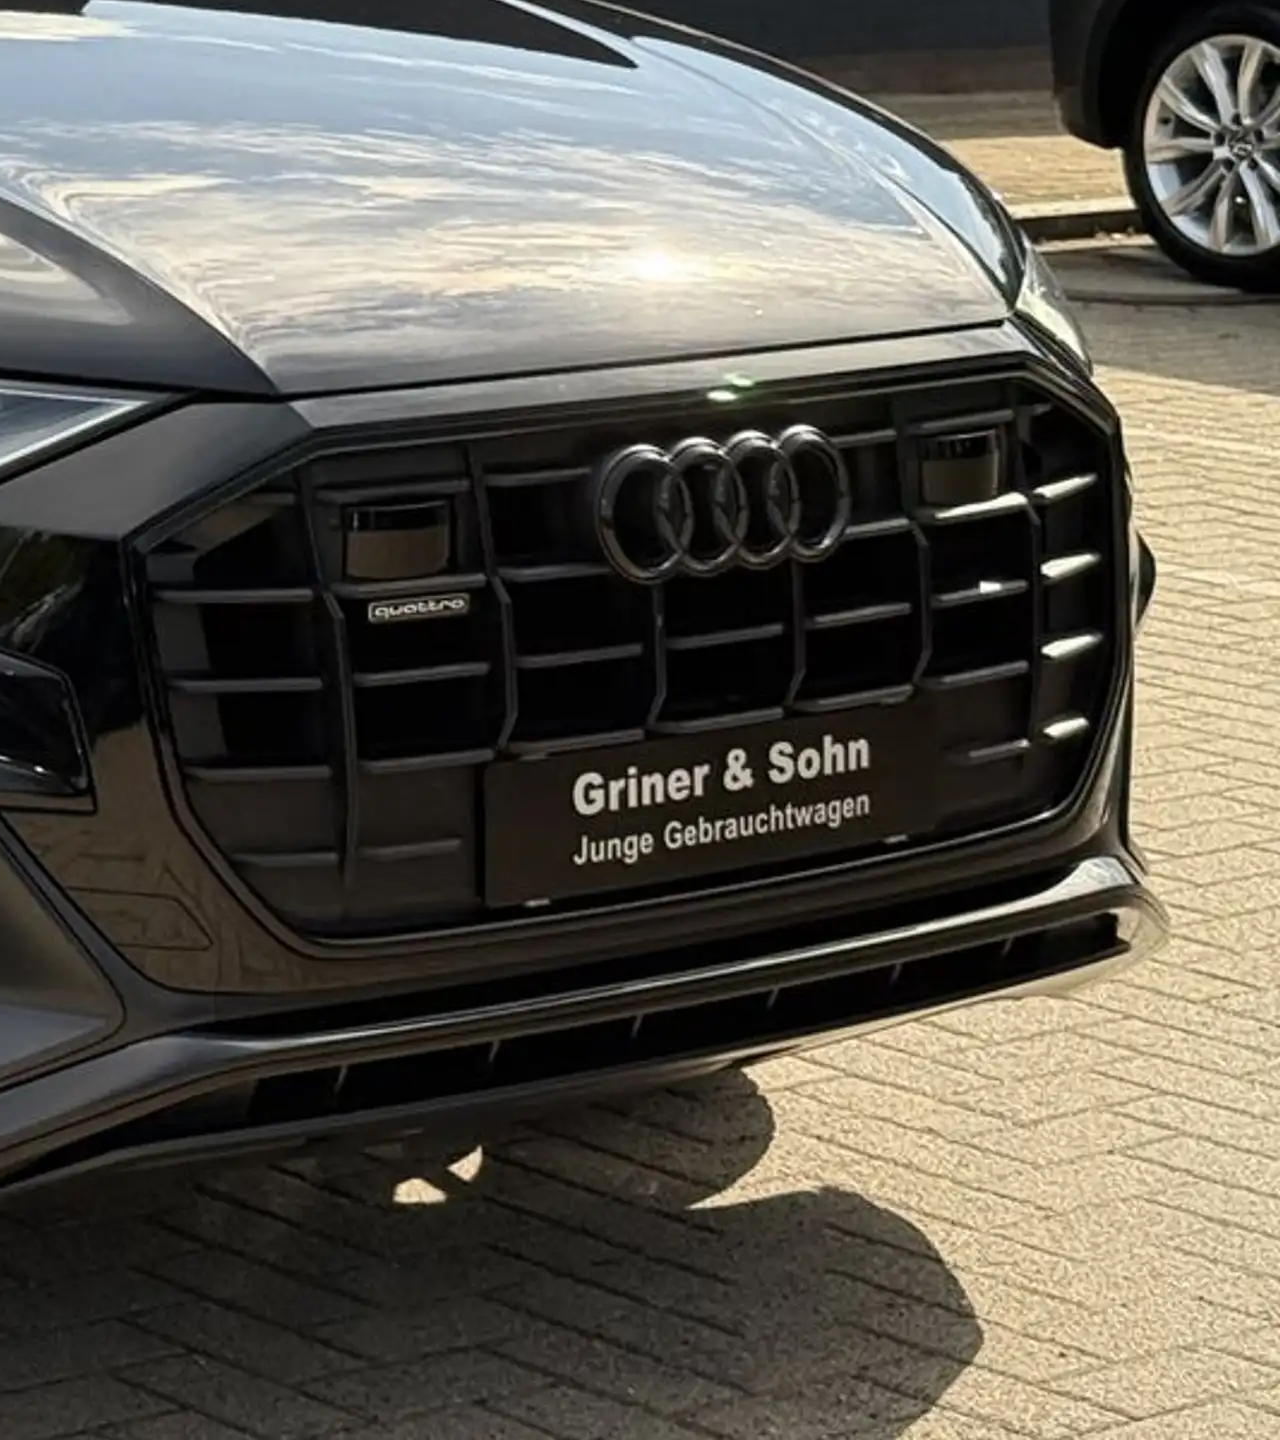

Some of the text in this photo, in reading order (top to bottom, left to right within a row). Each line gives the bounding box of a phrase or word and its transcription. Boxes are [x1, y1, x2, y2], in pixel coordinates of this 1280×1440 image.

[375, 598, 466, 621] quattro
[572, 733, 870, 816] Griner & Sohn
[572, 792, 870, 865] Junge Gebrauchtwagen
